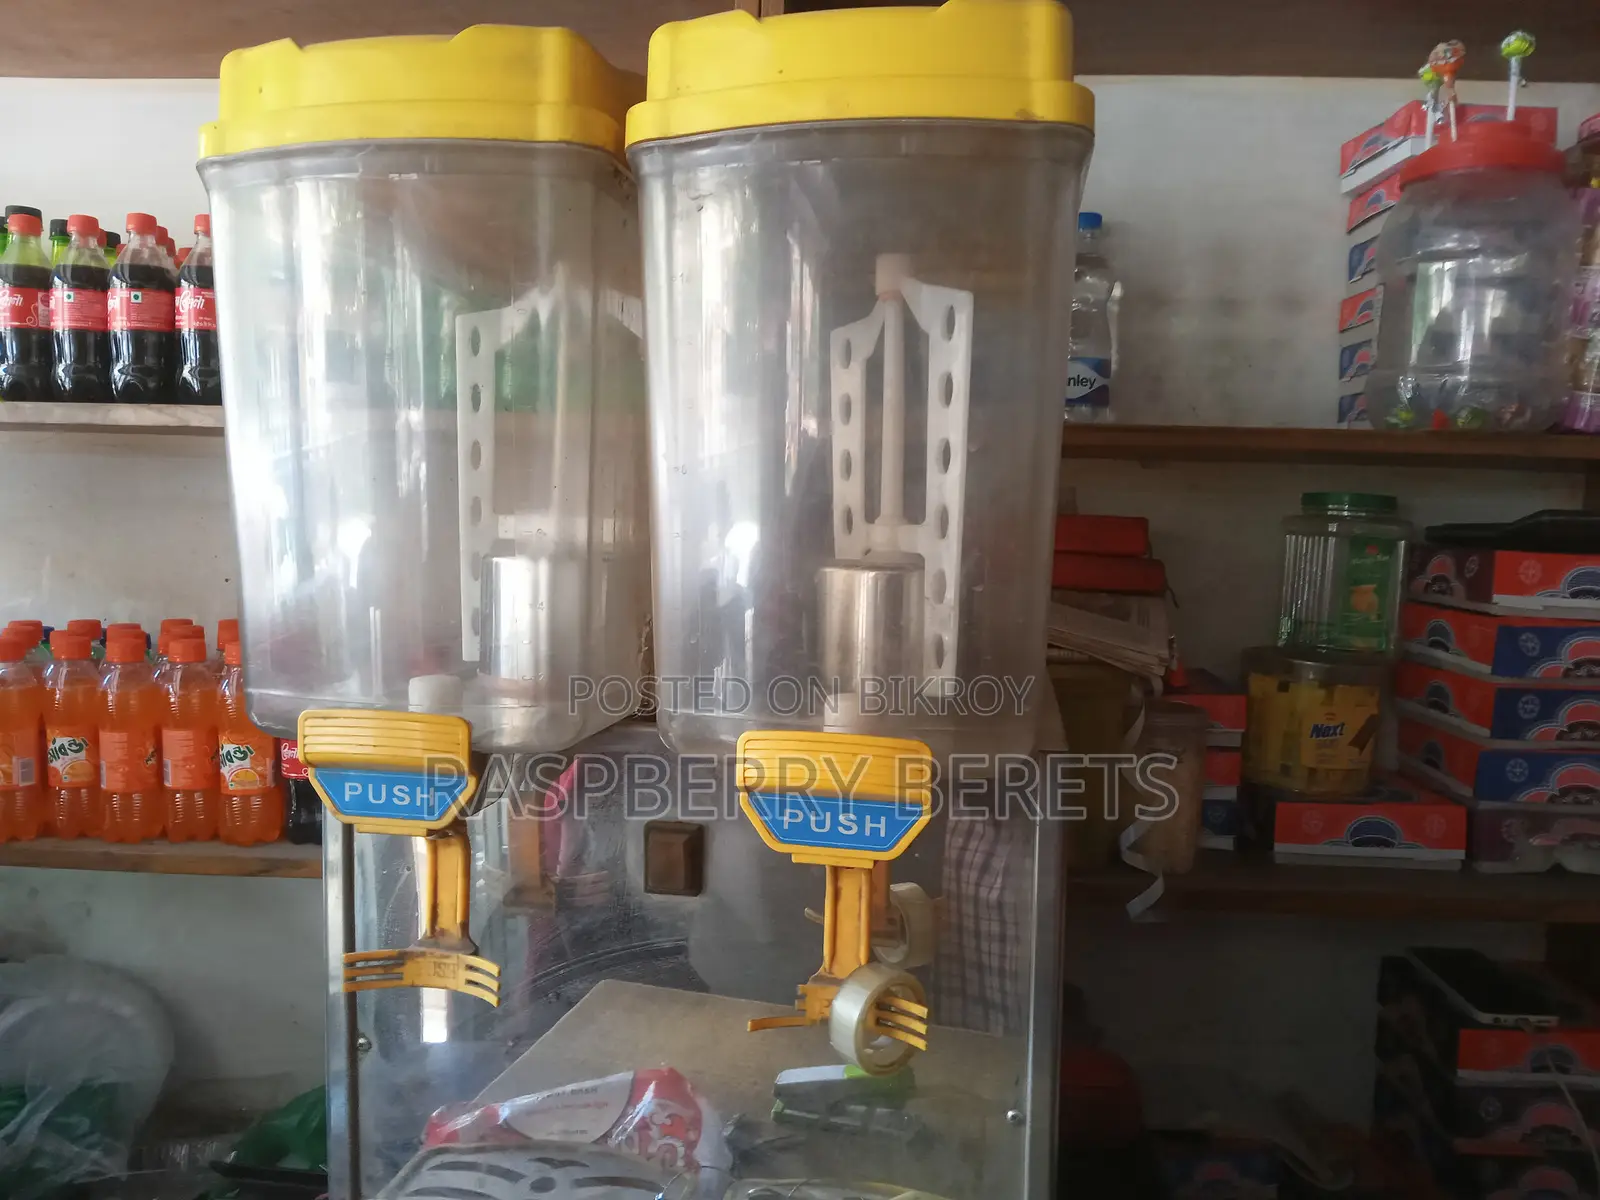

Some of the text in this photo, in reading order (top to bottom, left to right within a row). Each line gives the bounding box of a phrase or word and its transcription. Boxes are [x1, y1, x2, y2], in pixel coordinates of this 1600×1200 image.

[1067, 374, 1097, 390] nley
[343, 781, 436, 808] PUSH
[781, 807, 888, 839] PUSH
